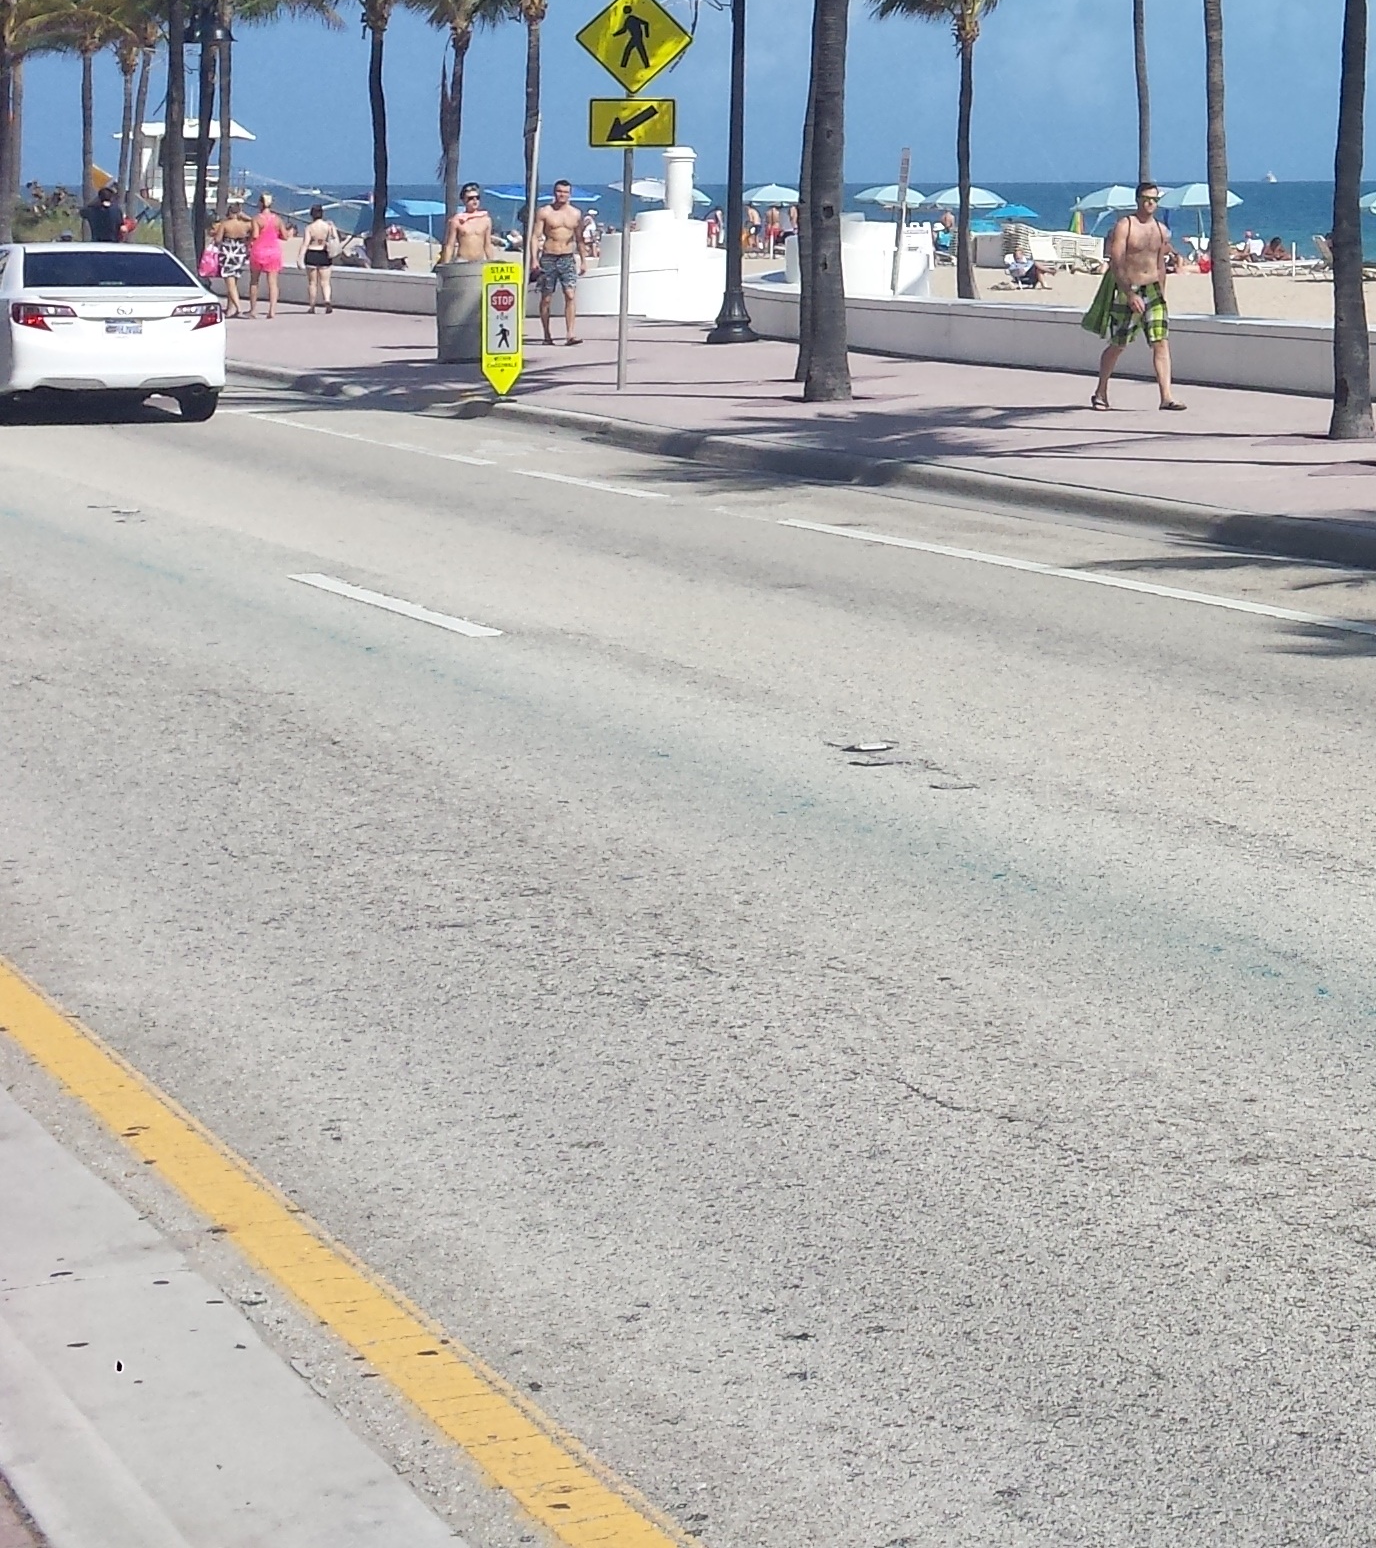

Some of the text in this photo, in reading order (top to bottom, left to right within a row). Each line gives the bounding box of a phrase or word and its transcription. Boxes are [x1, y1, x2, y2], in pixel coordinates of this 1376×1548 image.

[490, 266, 515, 274] STATE
[494, 274, 511, 282] LAW
[492, 295, 514, 305] STOP
